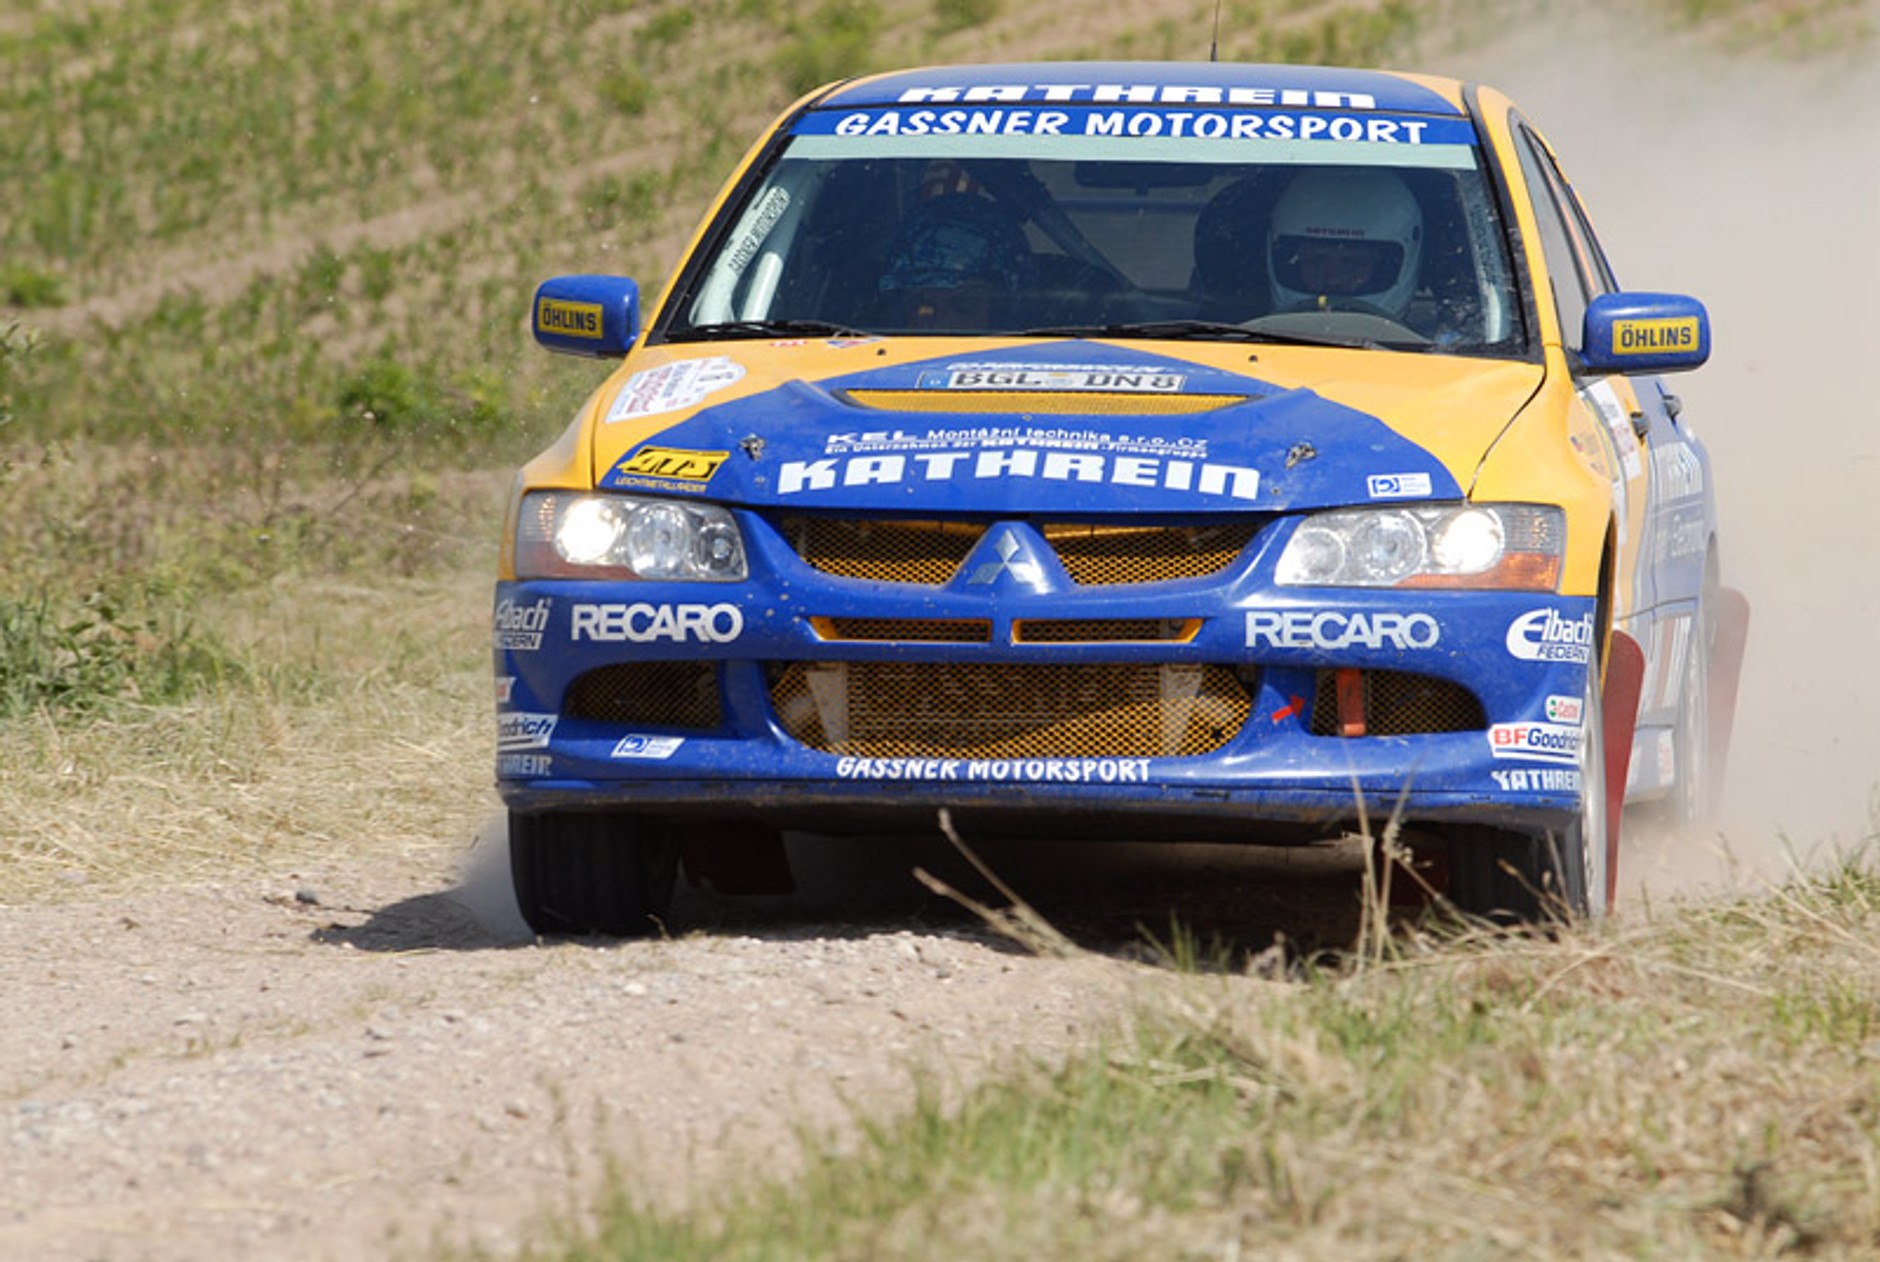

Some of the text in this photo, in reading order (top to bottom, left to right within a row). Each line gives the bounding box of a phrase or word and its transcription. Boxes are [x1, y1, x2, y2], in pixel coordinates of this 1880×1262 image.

[898, 84, 1375, 109] KATHREIN
[835, 110, 1427, 144] GASSNER MOTORSPORT
[1621, 324, 1691, 348] ÖHLINS
[777, 449, 1260, 500] KATHREIN
[571, 602, 744, 643] RECARO
[1245, 611, 1440, 650] RECARO
[836, 756, 1150, 783] GASSNER MOTORSPORT
